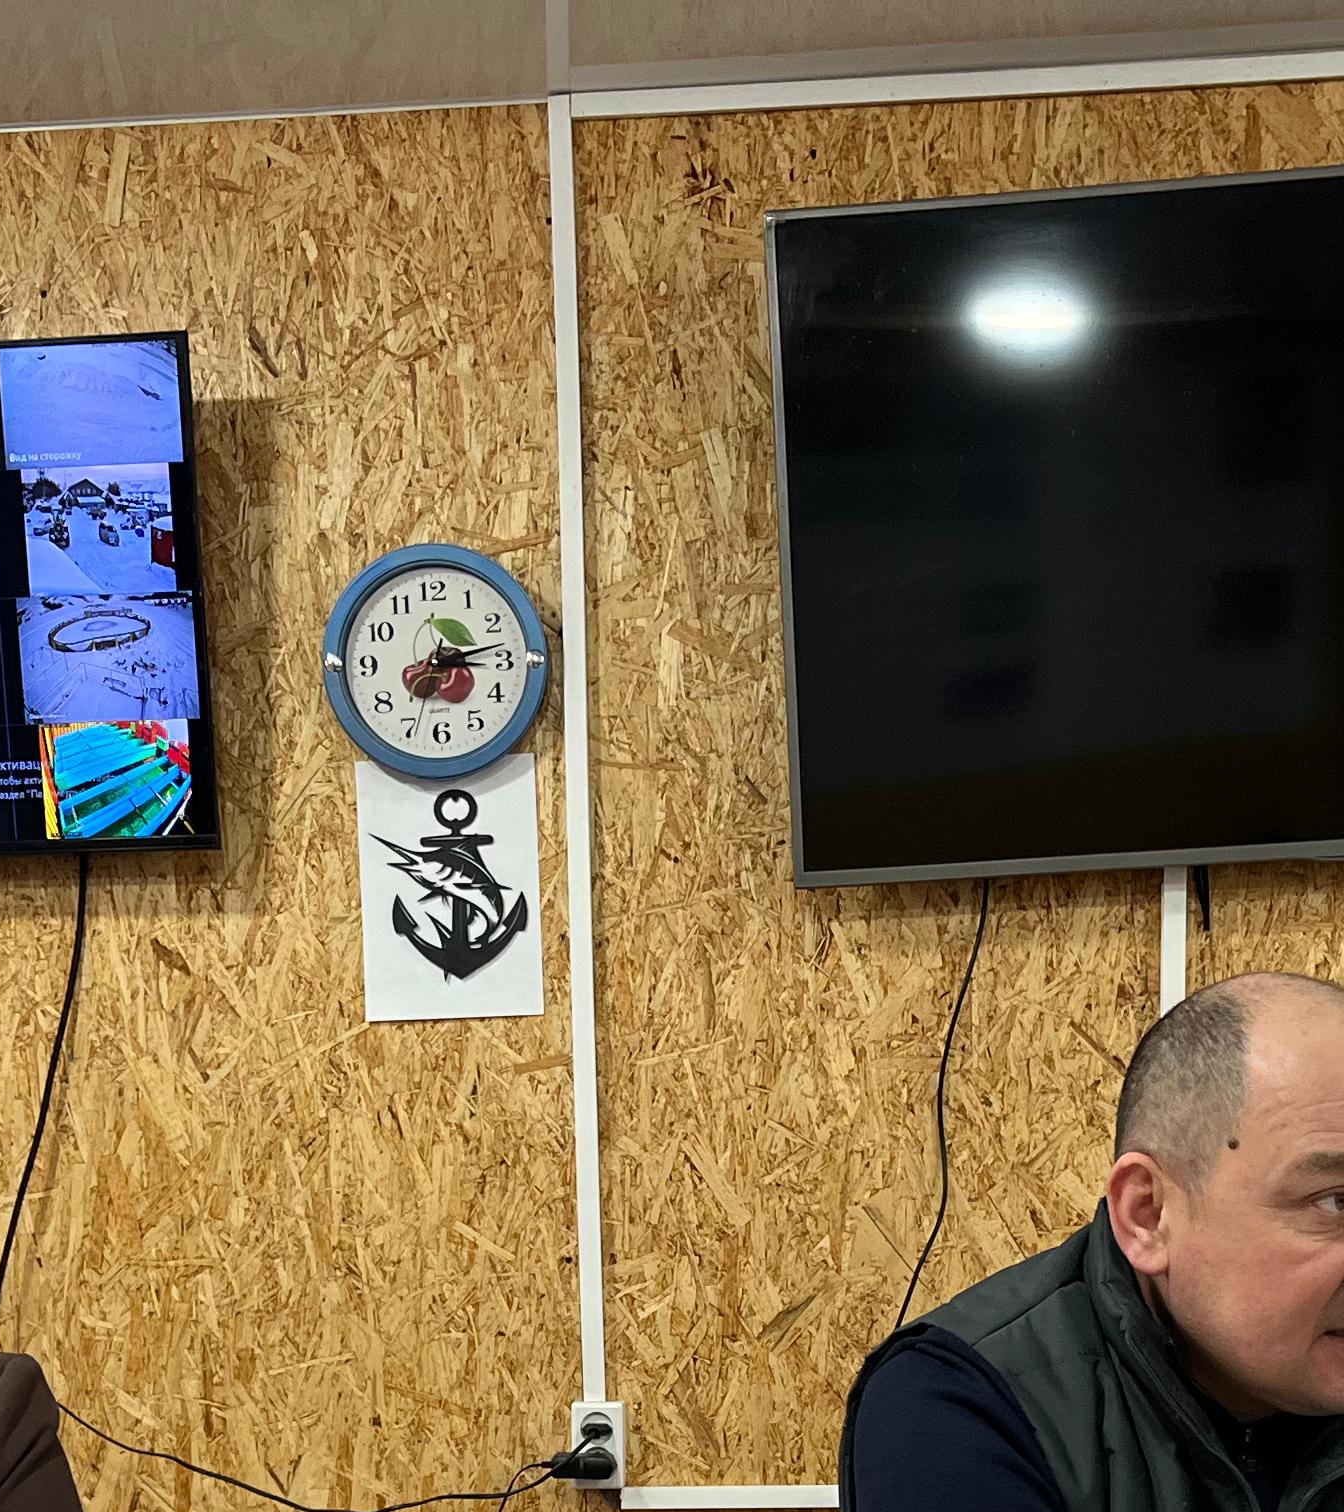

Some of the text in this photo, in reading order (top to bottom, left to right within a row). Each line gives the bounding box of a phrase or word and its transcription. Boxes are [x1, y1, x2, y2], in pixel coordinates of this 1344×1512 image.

[418, 580, 448, 602] 12
[462, 590, 473, 610] 1
[389, 595, 412, 616] 11
[367, 621, 395, 643] 10
[484, 613, 503, 634] 2
[359, 655, 379, 677] 9
[495, 649, 515, 672] 3
[374, 690, 394, 714] 8
[487, 681, 506, 703] 4
[400, 717, 417, 739] 7
[467, 709, 485, 732] 5
[432, 721, 452, 745] 6
